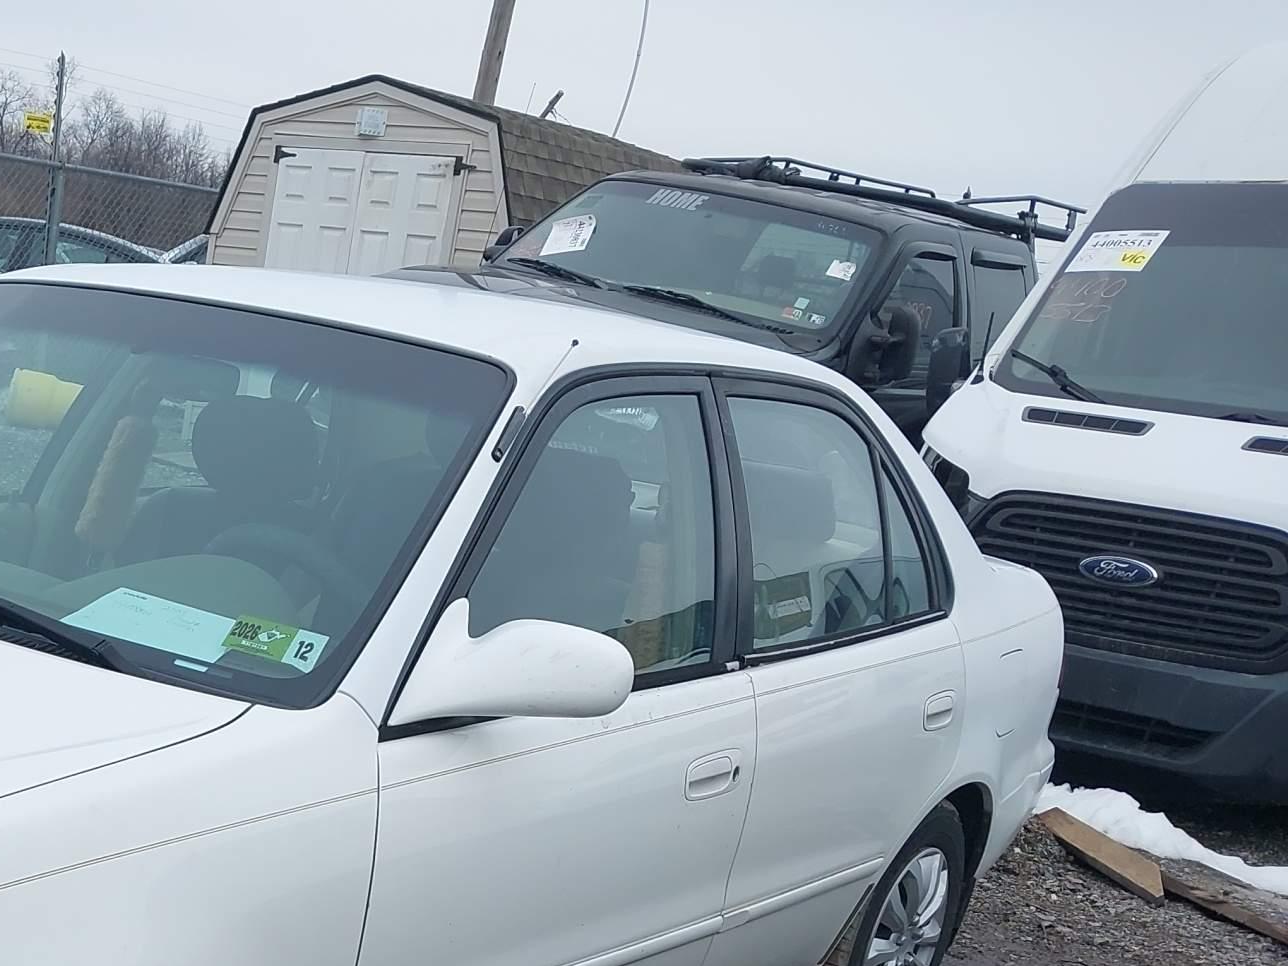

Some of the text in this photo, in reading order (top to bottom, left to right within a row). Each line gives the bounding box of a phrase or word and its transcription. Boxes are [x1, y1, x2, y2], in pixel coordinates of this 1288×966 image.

[645, 189, 710, 211] HOME
[1091, 239, 1153, 248] 44005513
[1121, 251, 1146, 264] VIC
[1094, 560, 1139, 579] Ford
[230, 621, 262, 641] 2026
[293, 640, 315, 662] 12
